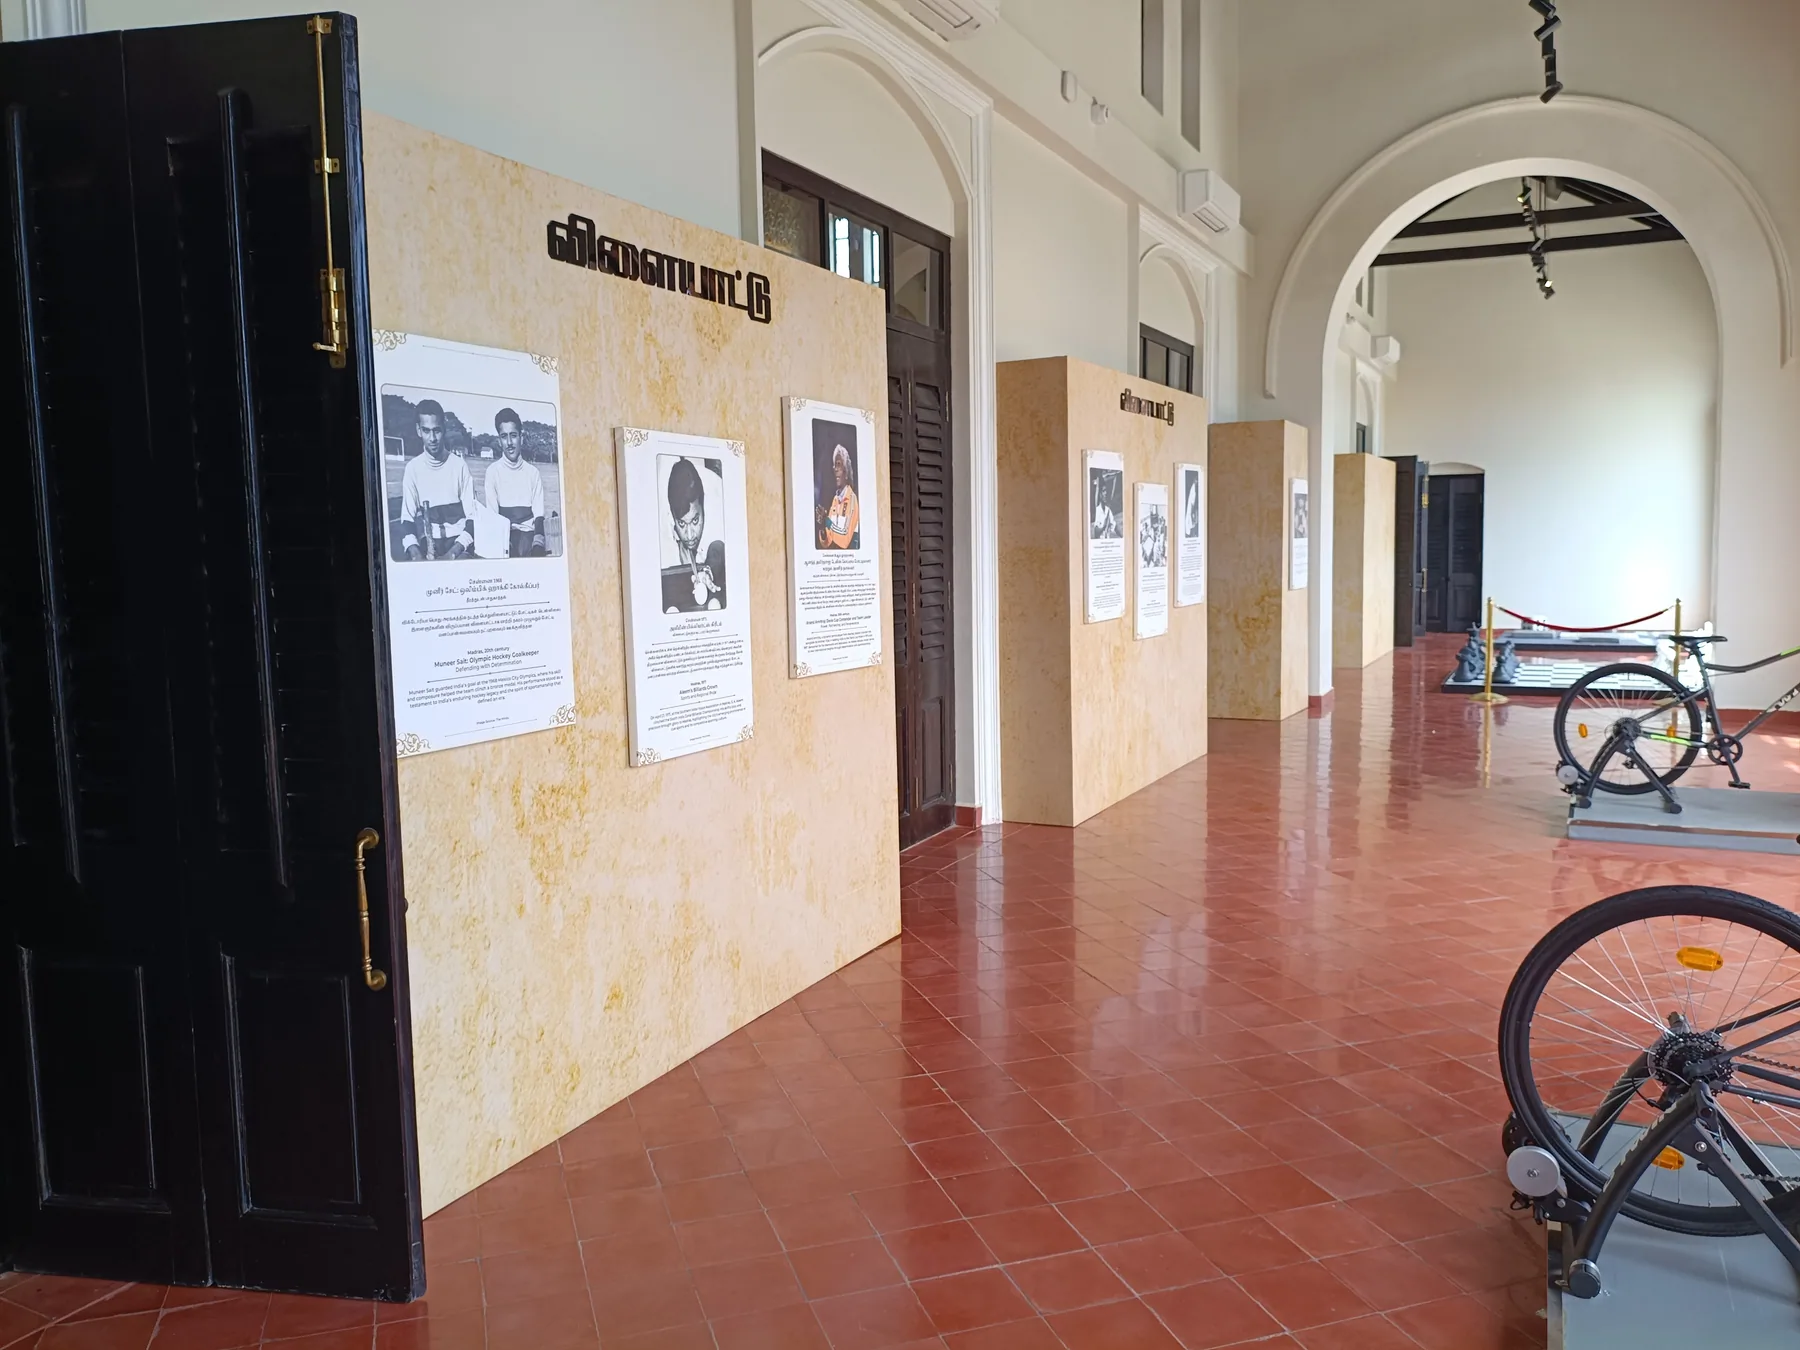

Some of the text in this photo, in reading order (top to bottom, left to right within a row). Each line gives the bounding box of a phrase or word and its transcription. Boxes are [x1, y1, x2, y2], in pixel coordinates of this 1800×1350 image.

[547, 214, 772, 324] விளையாட்டு
[1120, 388, 1174, 426] விளையாட்டு
[456, 664, 479, 672] Defending
[470, 655, 491, 664] Olympic
[512, 650, 539, 658] Goalkeeper
